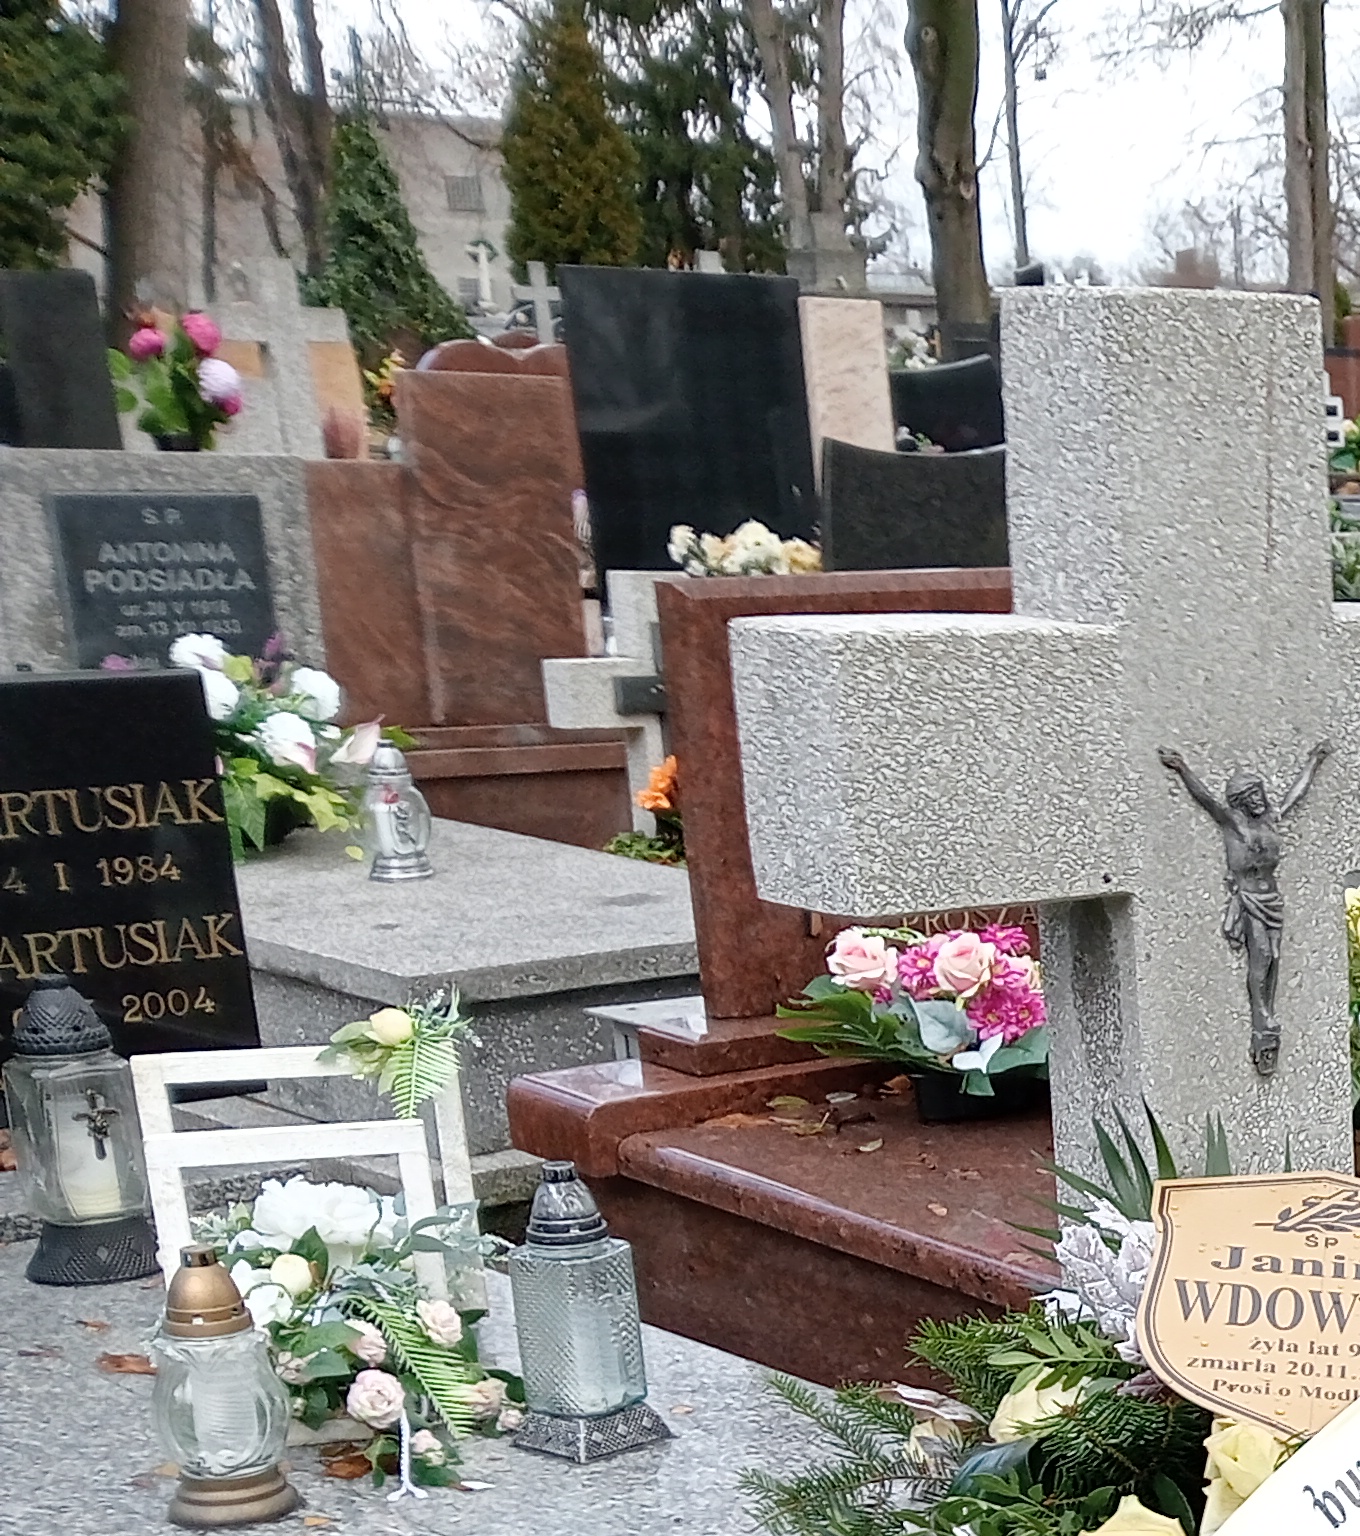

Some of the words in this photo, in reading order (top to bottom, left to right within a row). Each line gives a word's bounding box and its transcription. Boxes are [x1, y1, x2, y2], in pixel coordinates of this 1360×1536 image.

[98, 542, 236, 563] ANTONINA
[0, 778, 225, 840] RTUSIAK
[97, 853, 182, 887] 1984
[121, 986, 216, 1024] 2004
[1304, 1233, 1339, 1249] ŚP
[1308, 1340, 1340, 1357] lat
[1212, 1378, 1271, 1397] Prosi
[1278, 1385, 1292, 1397] o
